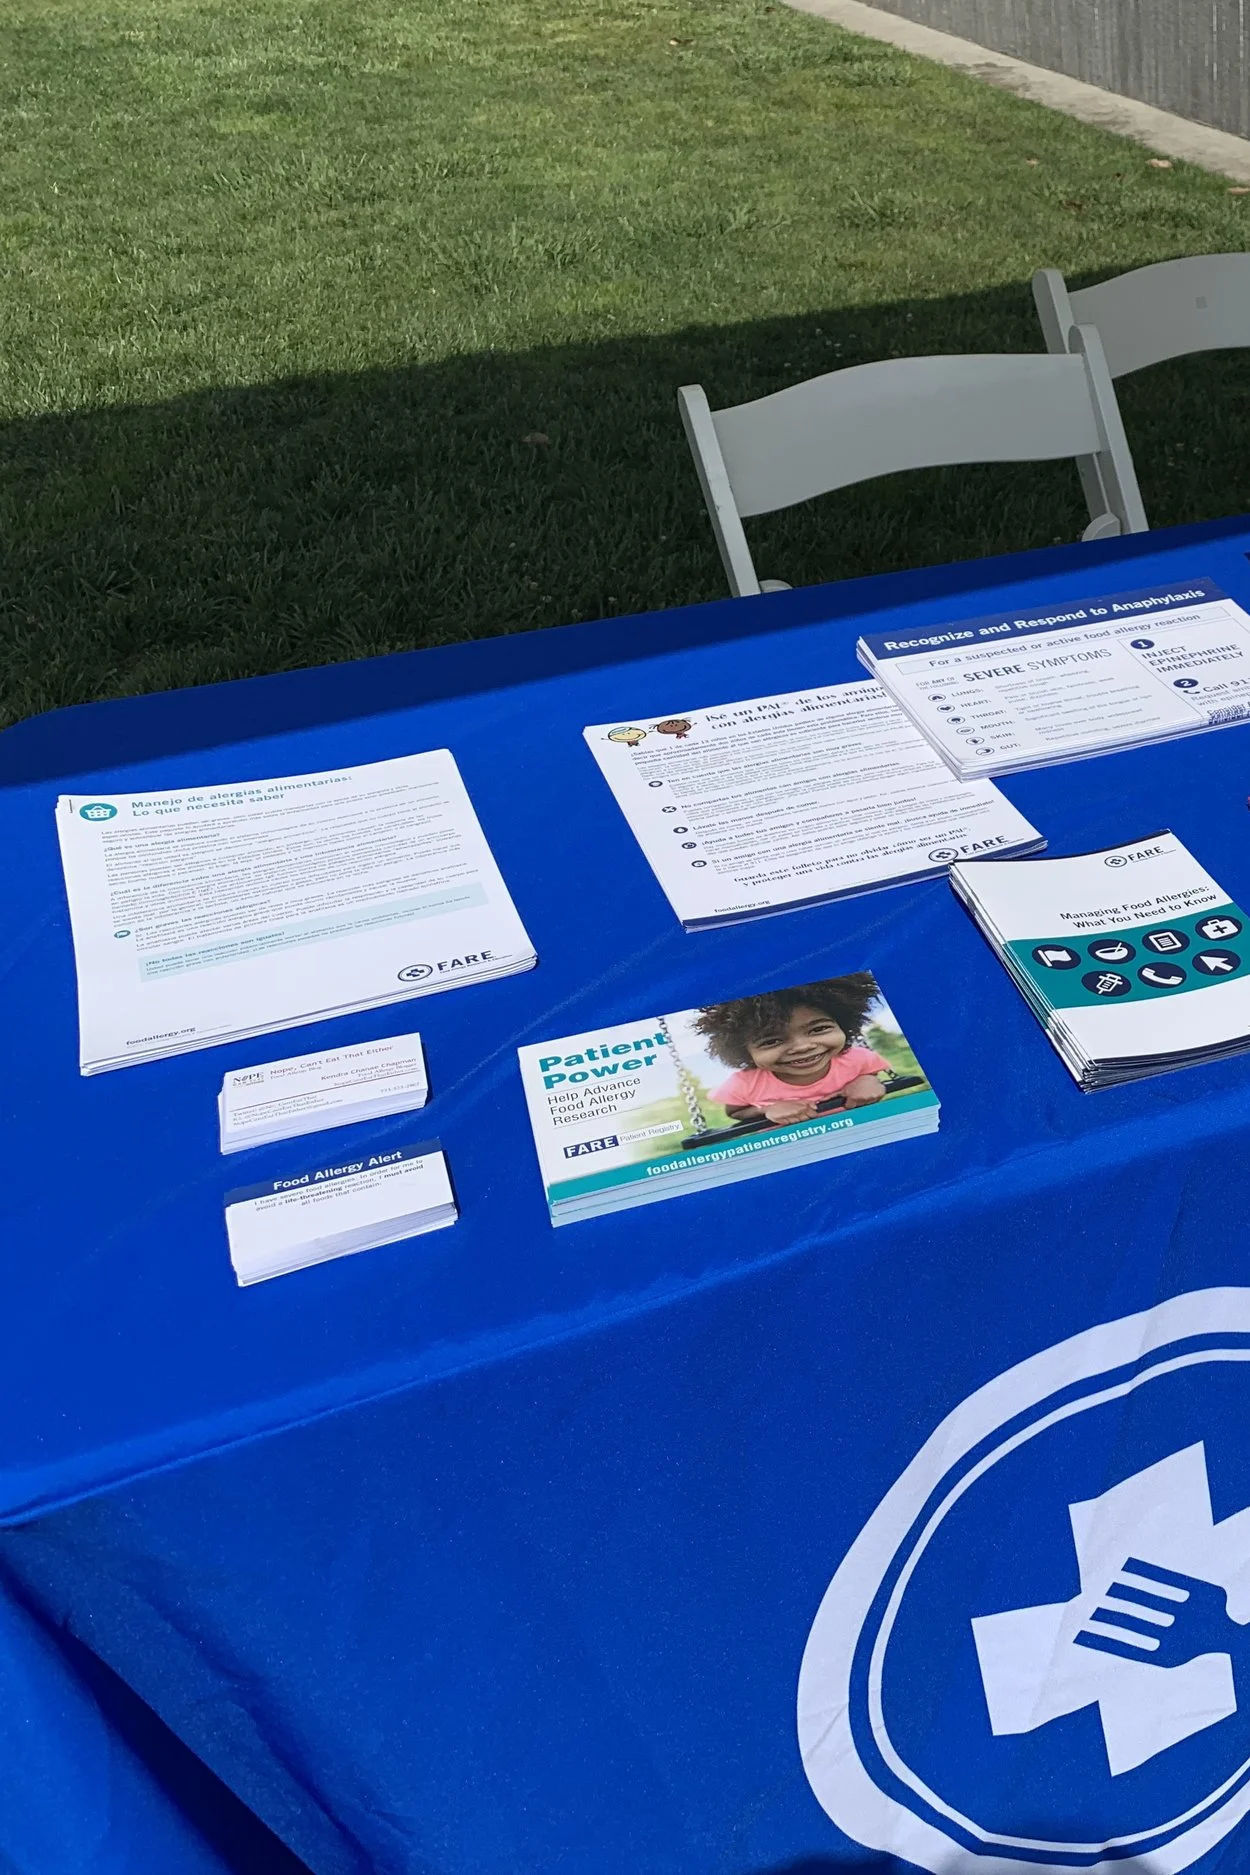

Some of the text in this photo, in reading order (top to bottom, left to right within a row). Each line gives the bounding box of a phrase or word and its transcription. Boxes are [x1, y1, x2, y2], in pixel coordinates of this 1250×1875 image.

[884, 631, 974, 650] Recognize
[978, 622, 1011, 635] and
[1013, 610, 1087, 629] Respond
[1112, 590, 1205, 612] Anaphylaxis
[965, 645, 1027, 660] suspected
[1046, 637, 1081, 646] active
[1084, 630, 1111, 639] food
[1114, 624, 1151, 634] allergy
[1154, 615, 1200, 626] reaction
[1141, 646, 1186, 659] INJECT
[963, 649, 1112, 682] SEVERE SYMPTOMS
[1148, 644, 1240, 666] EPINEPHRINE
[1156, 651, 1243, 673] IMMEDIATELY
[733, 709, 753, 717] un
[795, 698, 812, 706] de
[816, 693, 837, 702] los
[843, 685, 884, 697] amigo
[1202, 683, 1228, 692] Call
[711, 692, 887, 730] con alergias alimentarias!
[131, 798, 182, 811] Manejo
[210, 789, 262, 800] alergias
[267, 776, 352, 792] alimentarias:
[155, 807, 180, 815] que
[186, 799, 244, 811] necesita
[249, 794, 284, 802] saber
[960, 835, 1010, 854] FARE
[1128, 846, 1164, 861] FARE
[1060, 885, 1209, 920] Managing Food Allergies:
[1073, 917, 1107, 929] What
[1108, 915, 1132, 924] You
[1135, 908, 1166, 919] Need
[1184, 894, 1217, 908] Know
[437, 950, 492, 970] FARE
[126, 1026, 196, 1045] foodallergy.org
[539, 1032, 668, 1073] Patient
[543, 1054, 658, 1090] Power
[547, 1076, 641, 1105] Help Advance
[550, 1089, 636, 1115] Food Allergy
[553, 1105, 617, 1126] Research
[566, 1123, 680, 1157] FARE Patient Registry
[646, 1116, 854, 1176] foodallergypatientregistry.org
[274, 1151, 402, 1191] Food Allergy Alert
[285, 1186, 342, 1204] life-threatening
[384, 1170, 402, 1178] must
[404, 1164, 423, 1172] avoid
